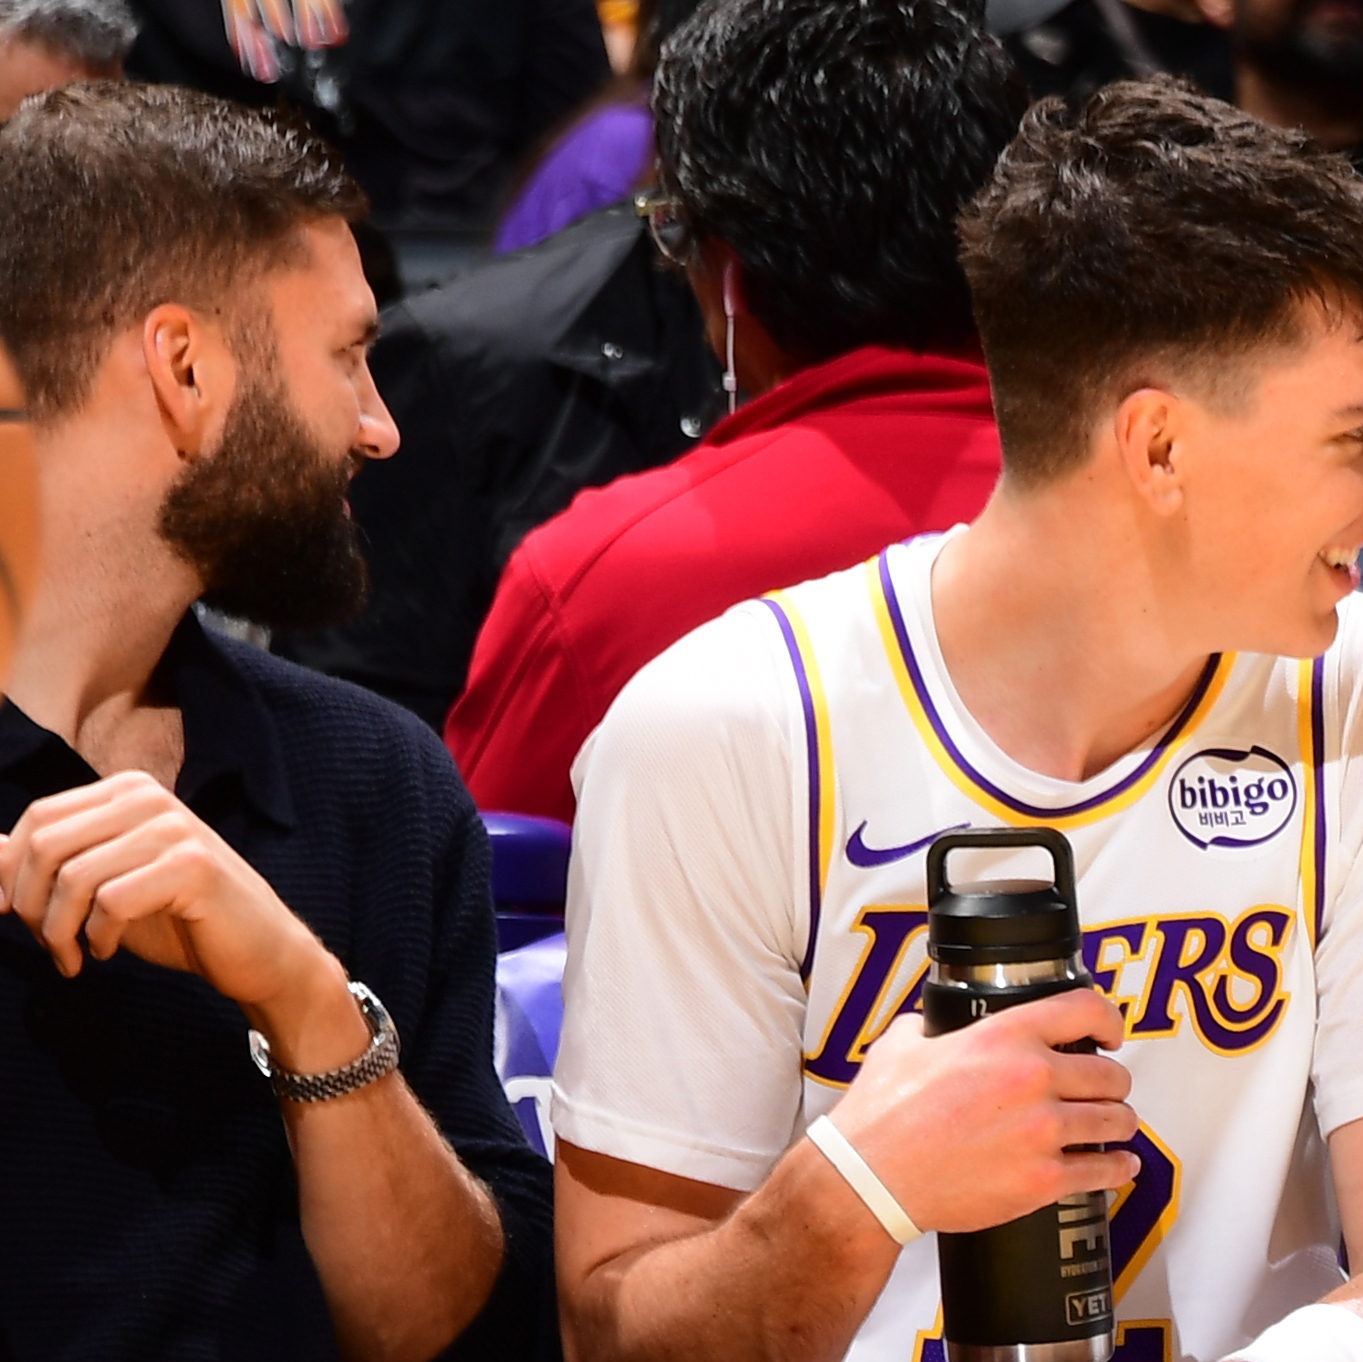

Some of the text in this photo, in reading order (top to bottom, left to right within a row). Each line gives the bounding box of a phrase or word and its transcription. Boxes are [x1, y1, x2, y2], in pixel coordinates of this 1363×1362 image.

[1179, 775, 1289, 816] bibigo
[1198, 810, 1247, 828] 비비고
[803, 904, 1298, 1089] LERS
